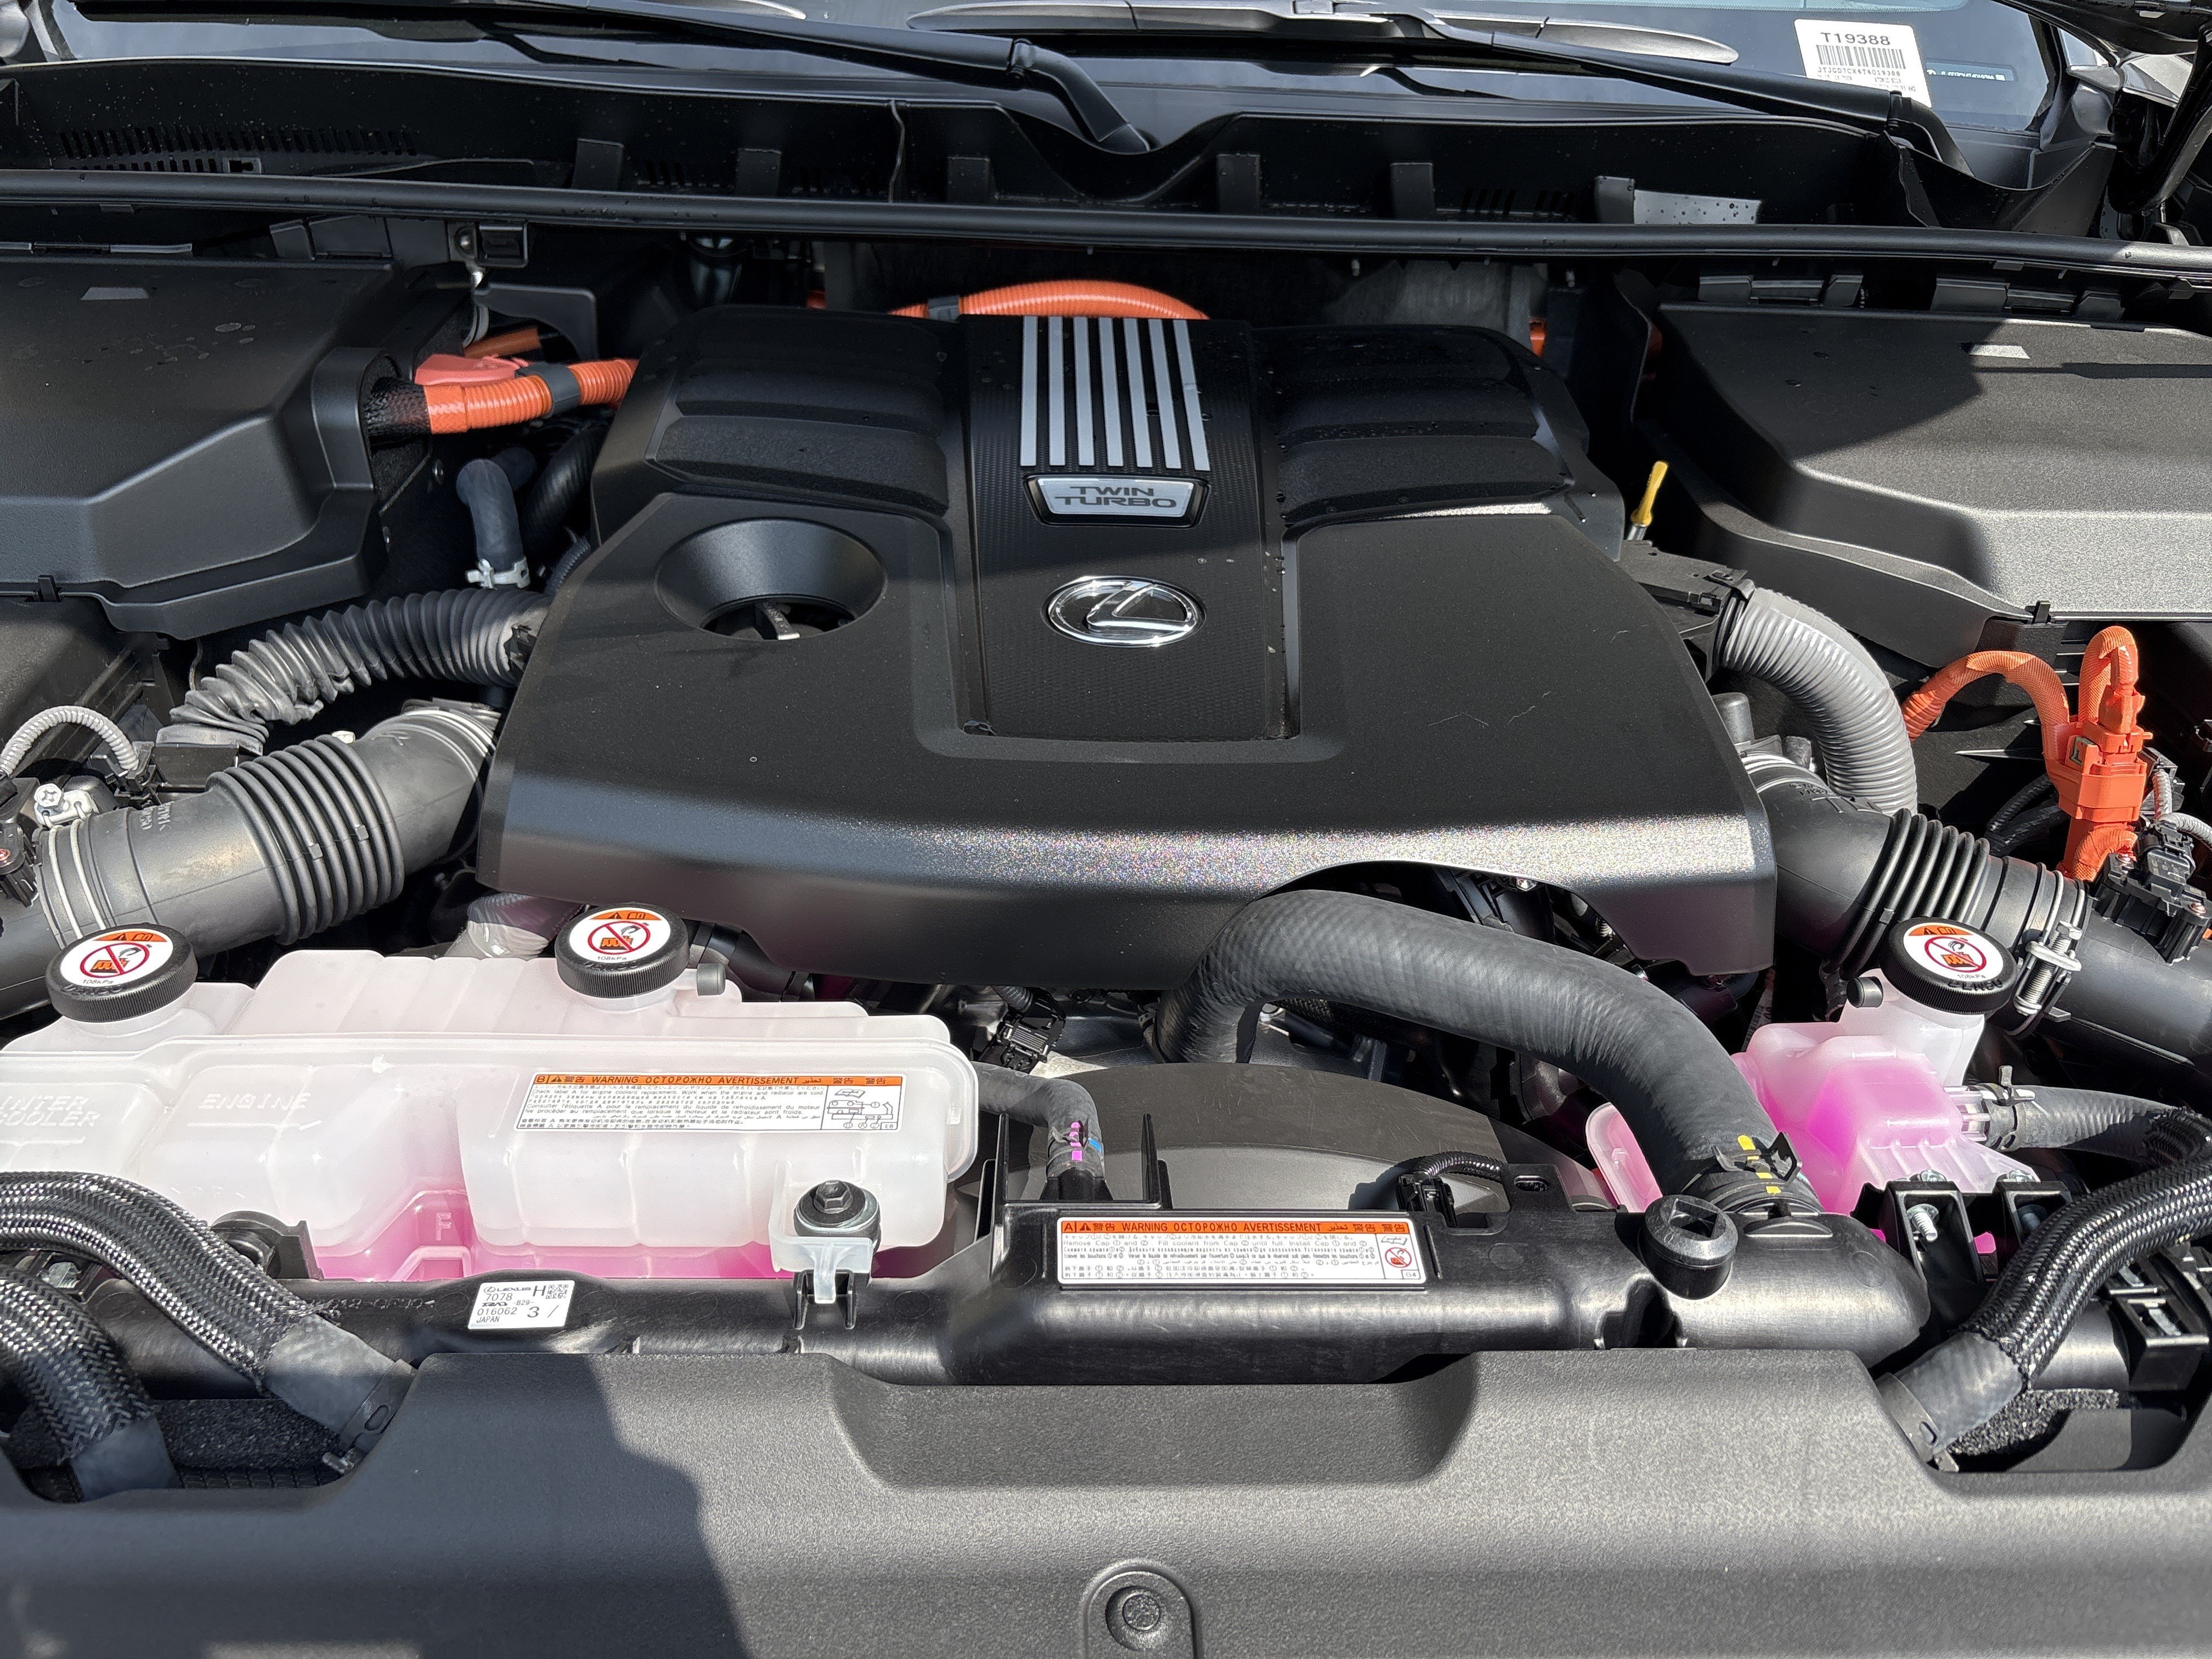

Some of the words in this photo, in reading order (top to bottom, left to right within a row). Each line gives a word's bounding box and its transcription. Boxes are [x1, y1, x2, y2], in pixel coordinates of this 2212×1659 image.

[1820, 32, 1891, 45] T19388
[1070, 486, 1154, 496] TWIN
[1054, 496, 1177, 508] TURBO
[0, 1095, 89, 1111] INTER
[198, 1092, 311, 1110] ENGINE
[436, 1212, 452, 1240] F
[1064, 1223, 1073, 1231] A
[1122, 1222, 1167, 1231] WARNING
[1173, 1222, 1238, 1232] ОСТОРОЖНО
[1243, 1223, 1321, 1232] AVERTISSEMENT
[1328, 1223, 1348, 1231] تحذير
[533, 1285, 546, 1296] H
[486, 1293, 513, 1301] 7078
[477, 1307, 517, 1316] 016062
[527, 1306, 540, 1318] 3
